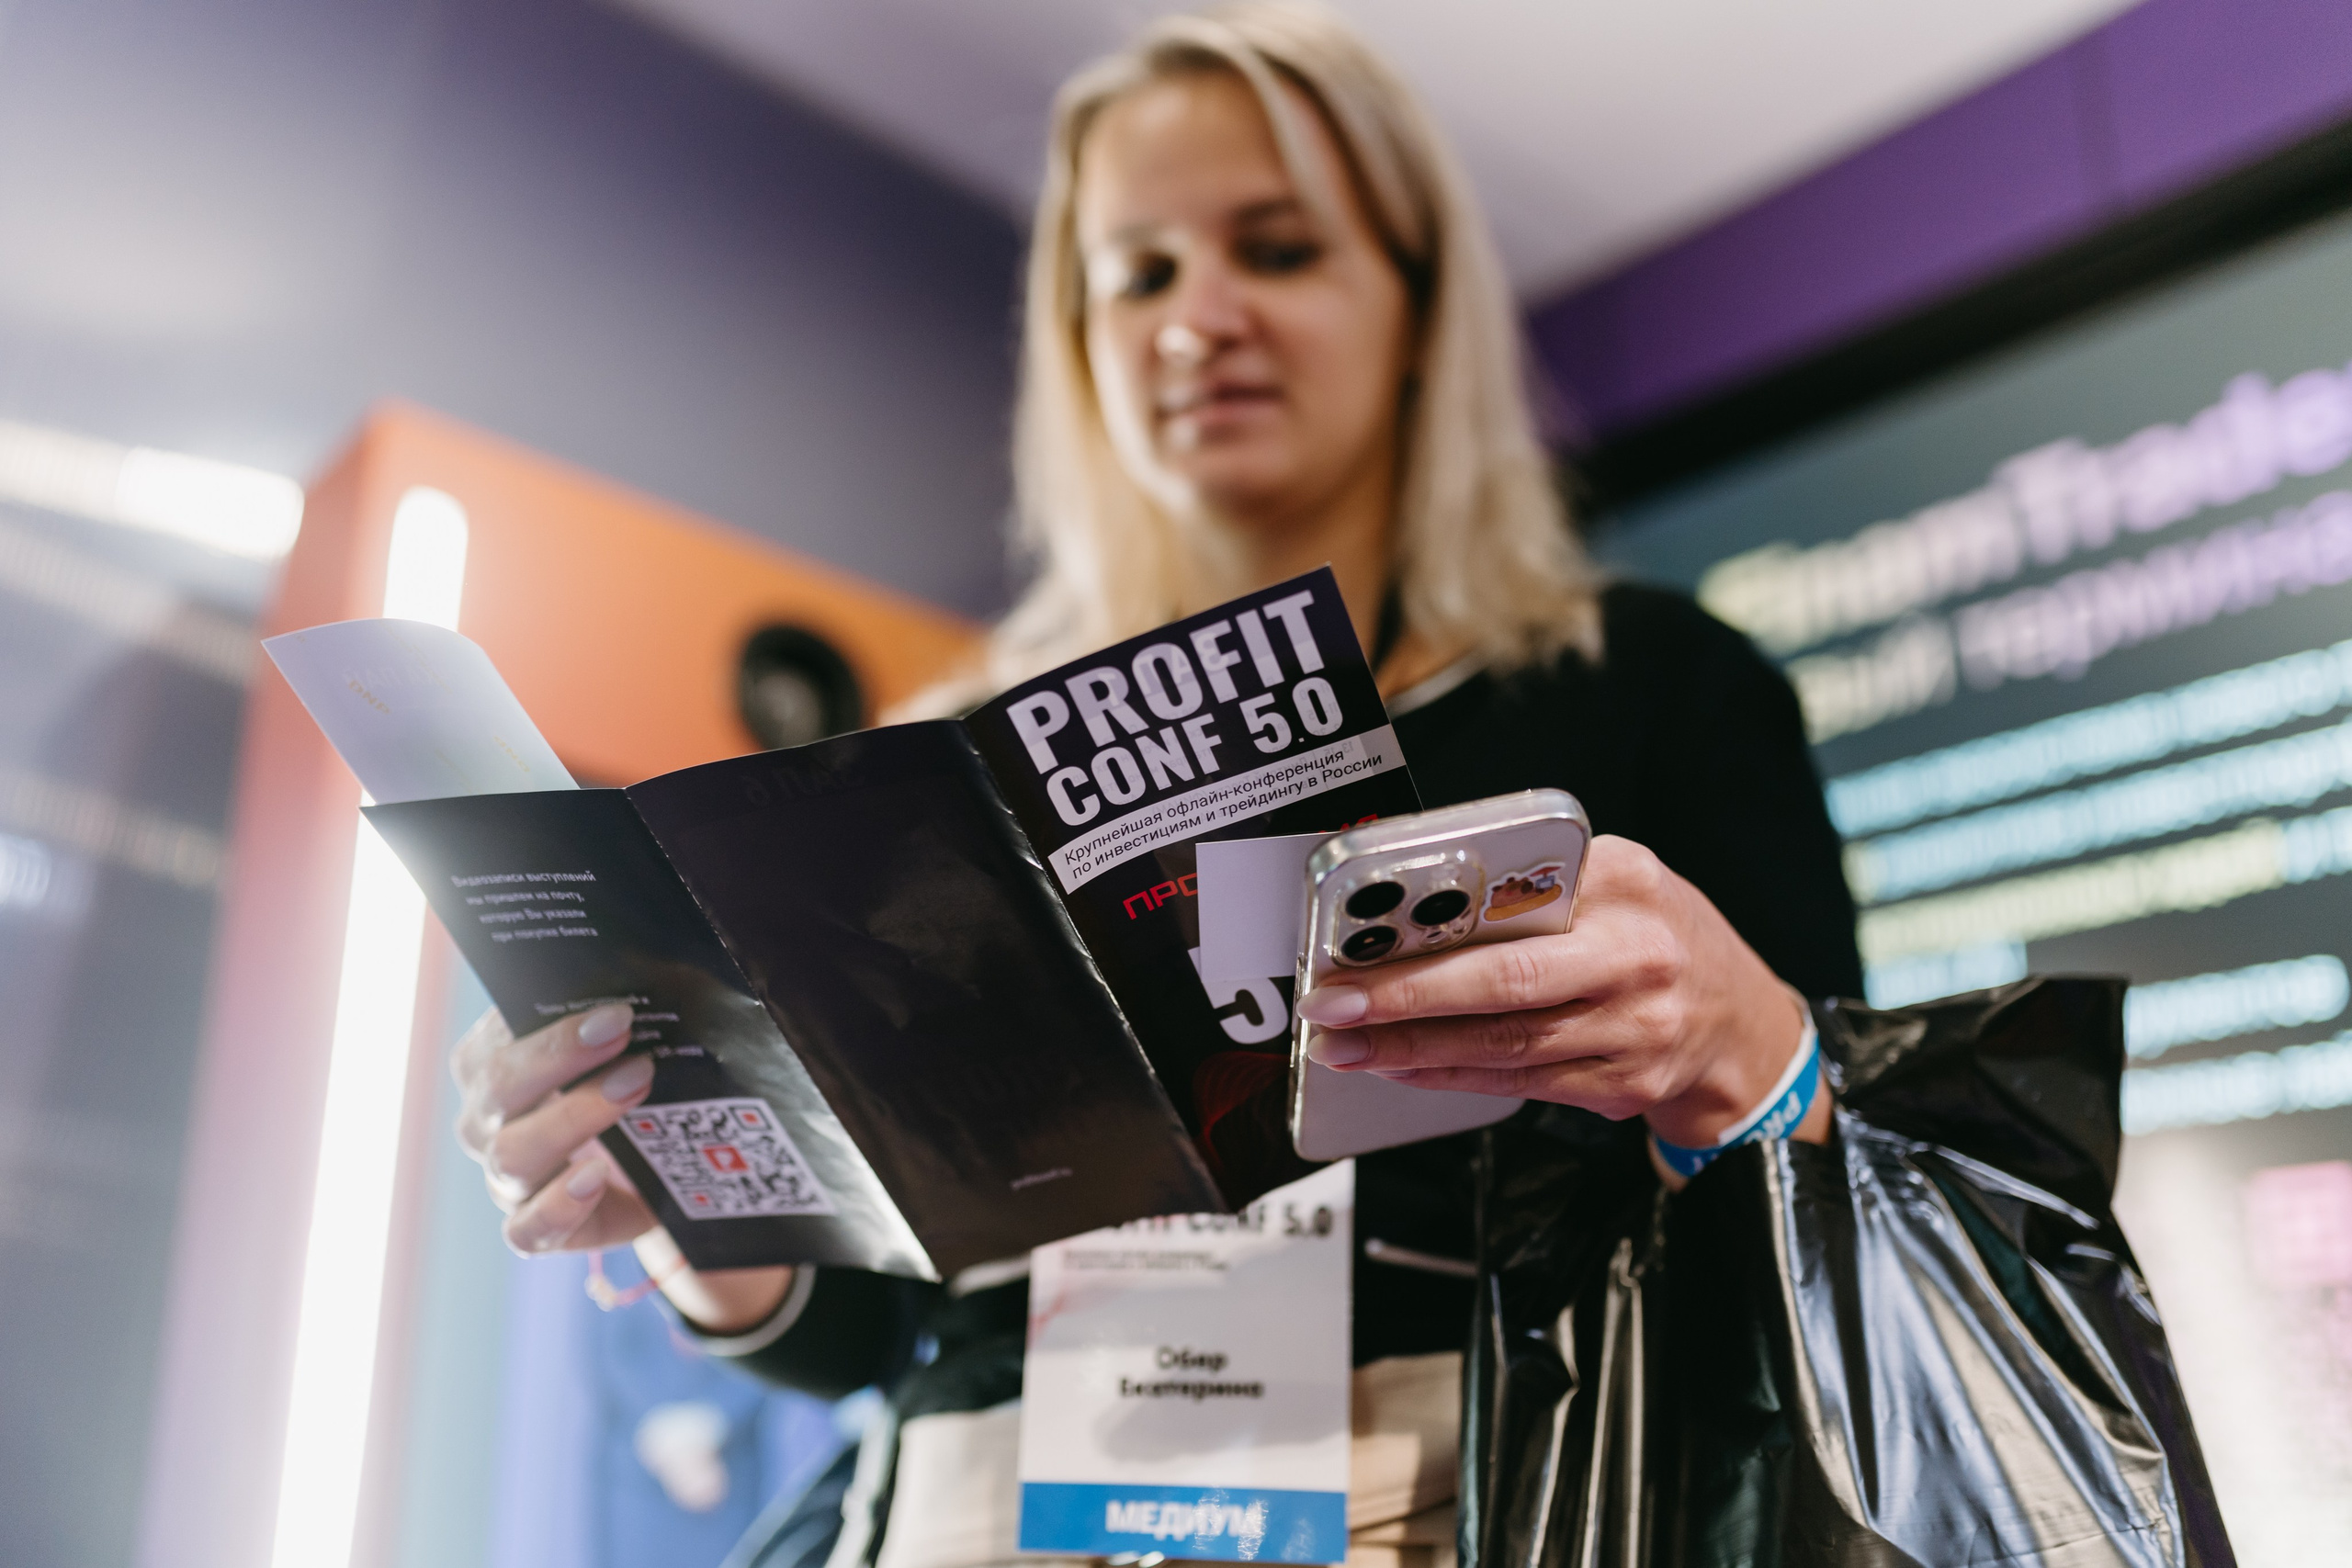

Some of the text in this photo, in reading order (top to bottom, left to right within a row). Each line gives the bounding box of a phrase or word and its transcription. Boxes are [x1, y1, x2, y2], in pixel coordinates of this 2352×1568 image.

[1006, 589, 1325, 774] PROFIT
[1046, 676, 1343, 826] CONF 5.0
[1065, 750, 1344, 866] Крупнейшая офлайн-конференция
[1072, 754, 1383, 879] по инвестициям и трейдингу в России
[526, 869, 597, 885] выступлений
[1105, 1499, 1269, 1541] МЕДИУМ
